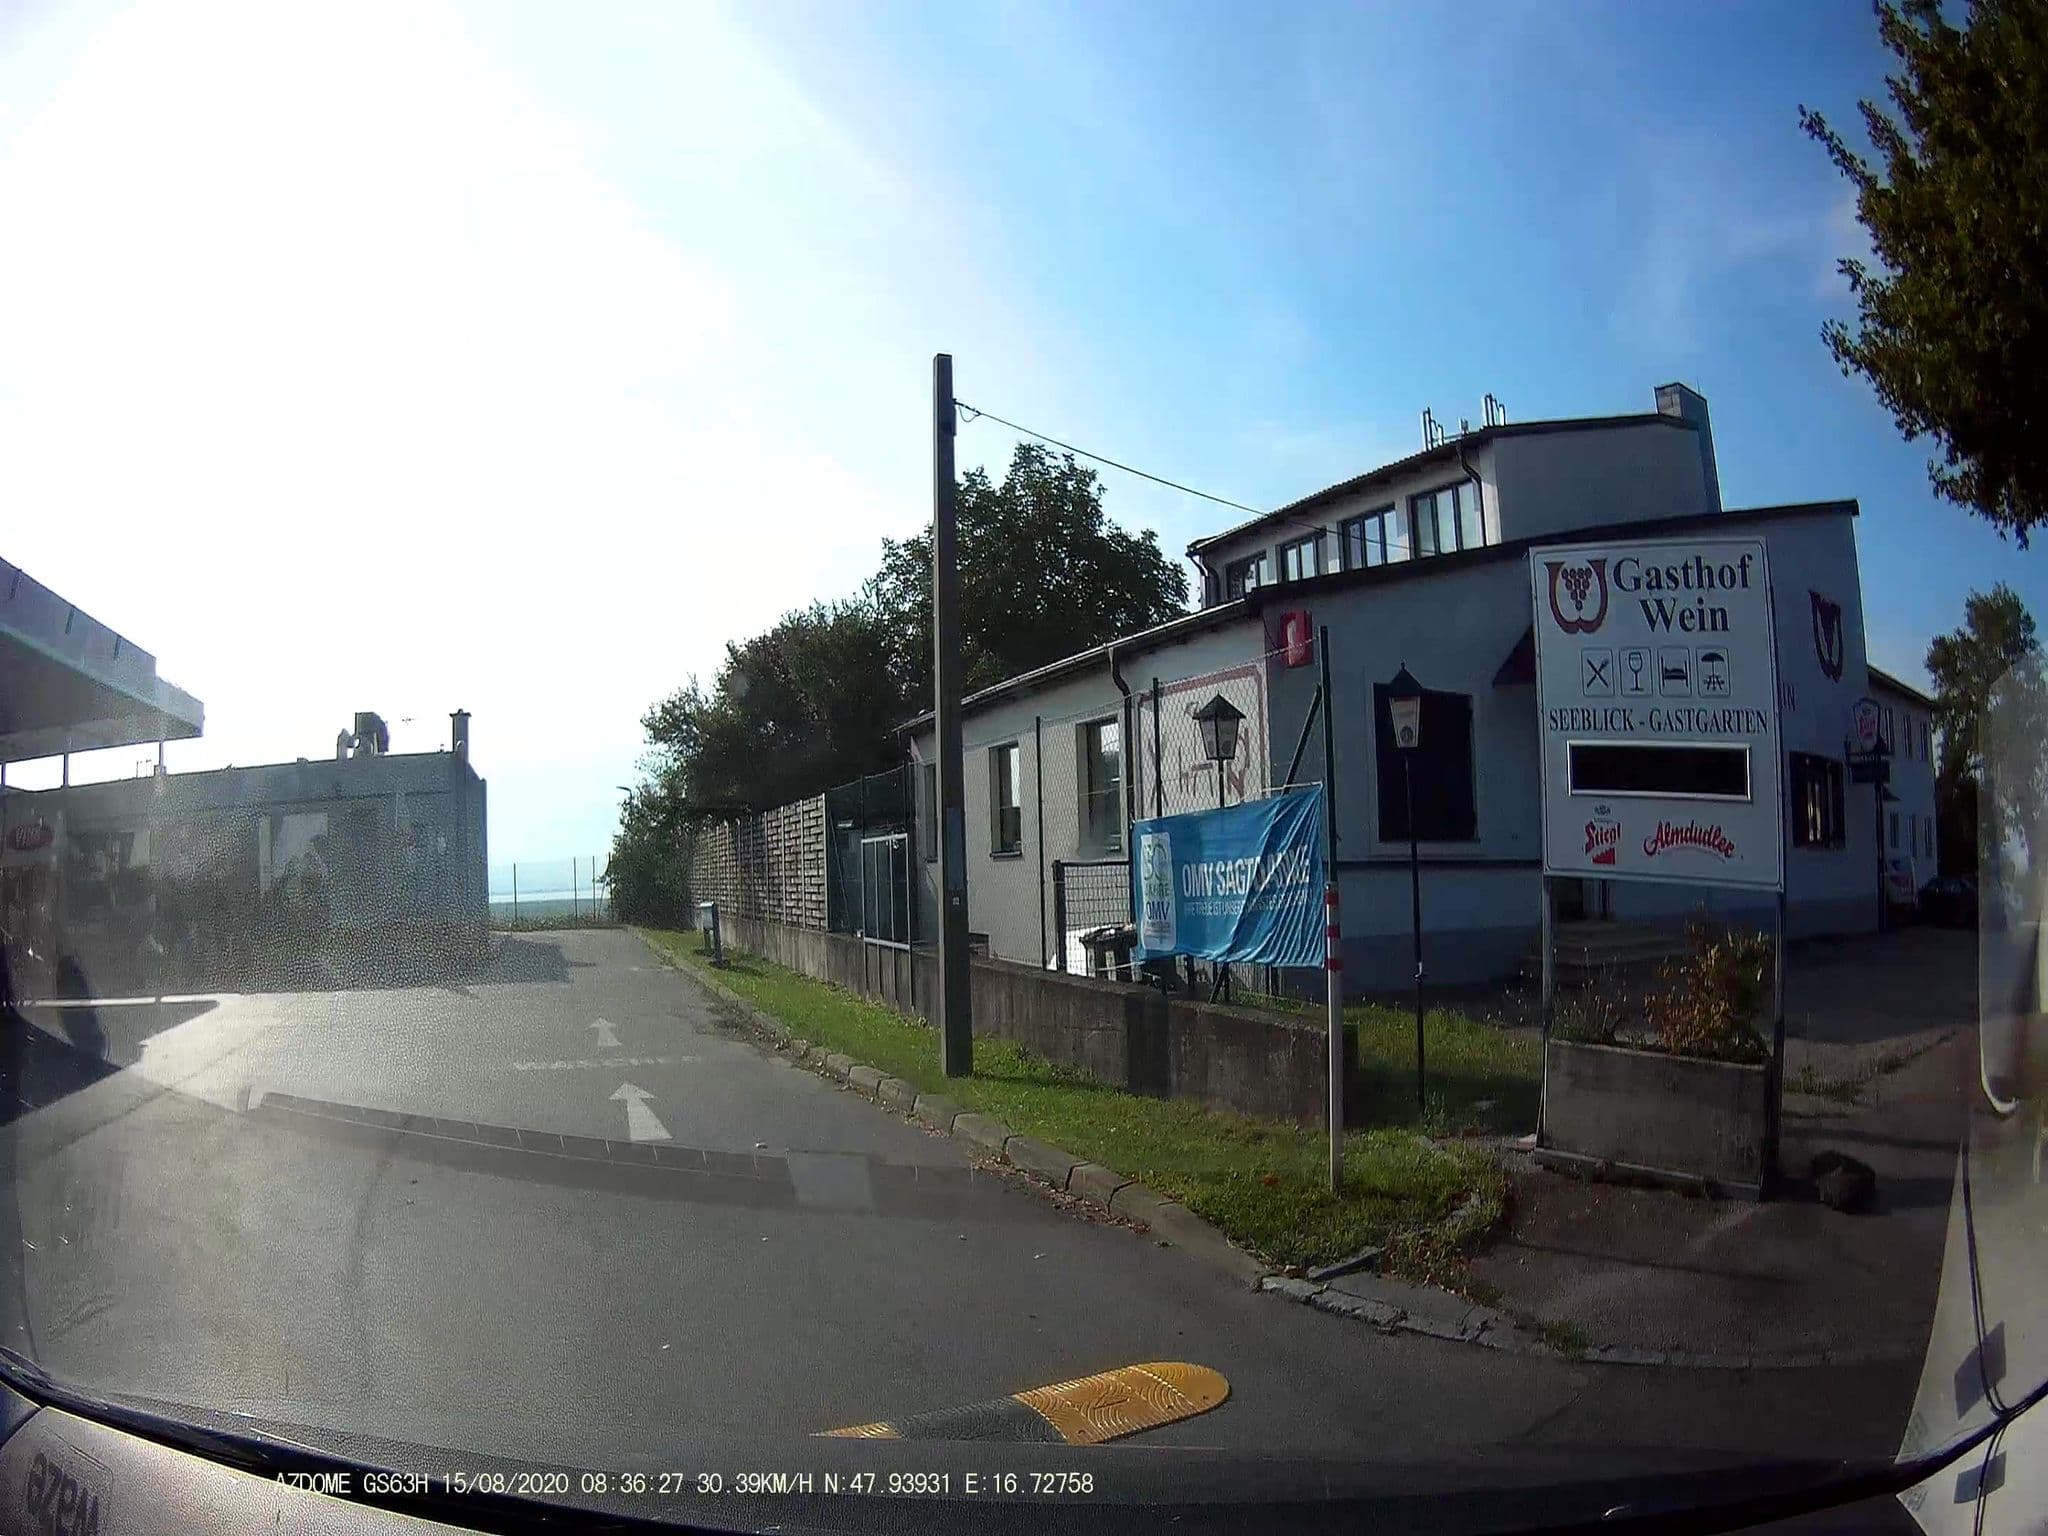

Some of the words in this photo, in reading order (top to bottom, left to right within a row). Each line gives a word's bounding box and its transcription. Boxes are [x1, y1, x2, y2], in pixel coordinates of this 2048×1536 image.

[1613, 554, 1753, 592] Gasthof
[1639, 597, 1730, 632] Wein
[1550, 707, 1634, 732] SEEBLICK
[1650, 708, 1768, 734] GASTGARTEN
[1643, 820, 1735, 858] Almdudler
[1182, 863, 1213, 897] OMV
[1215, 858, 1255, 896] SAGT
[1145, 901, 1171, 920] OMV
